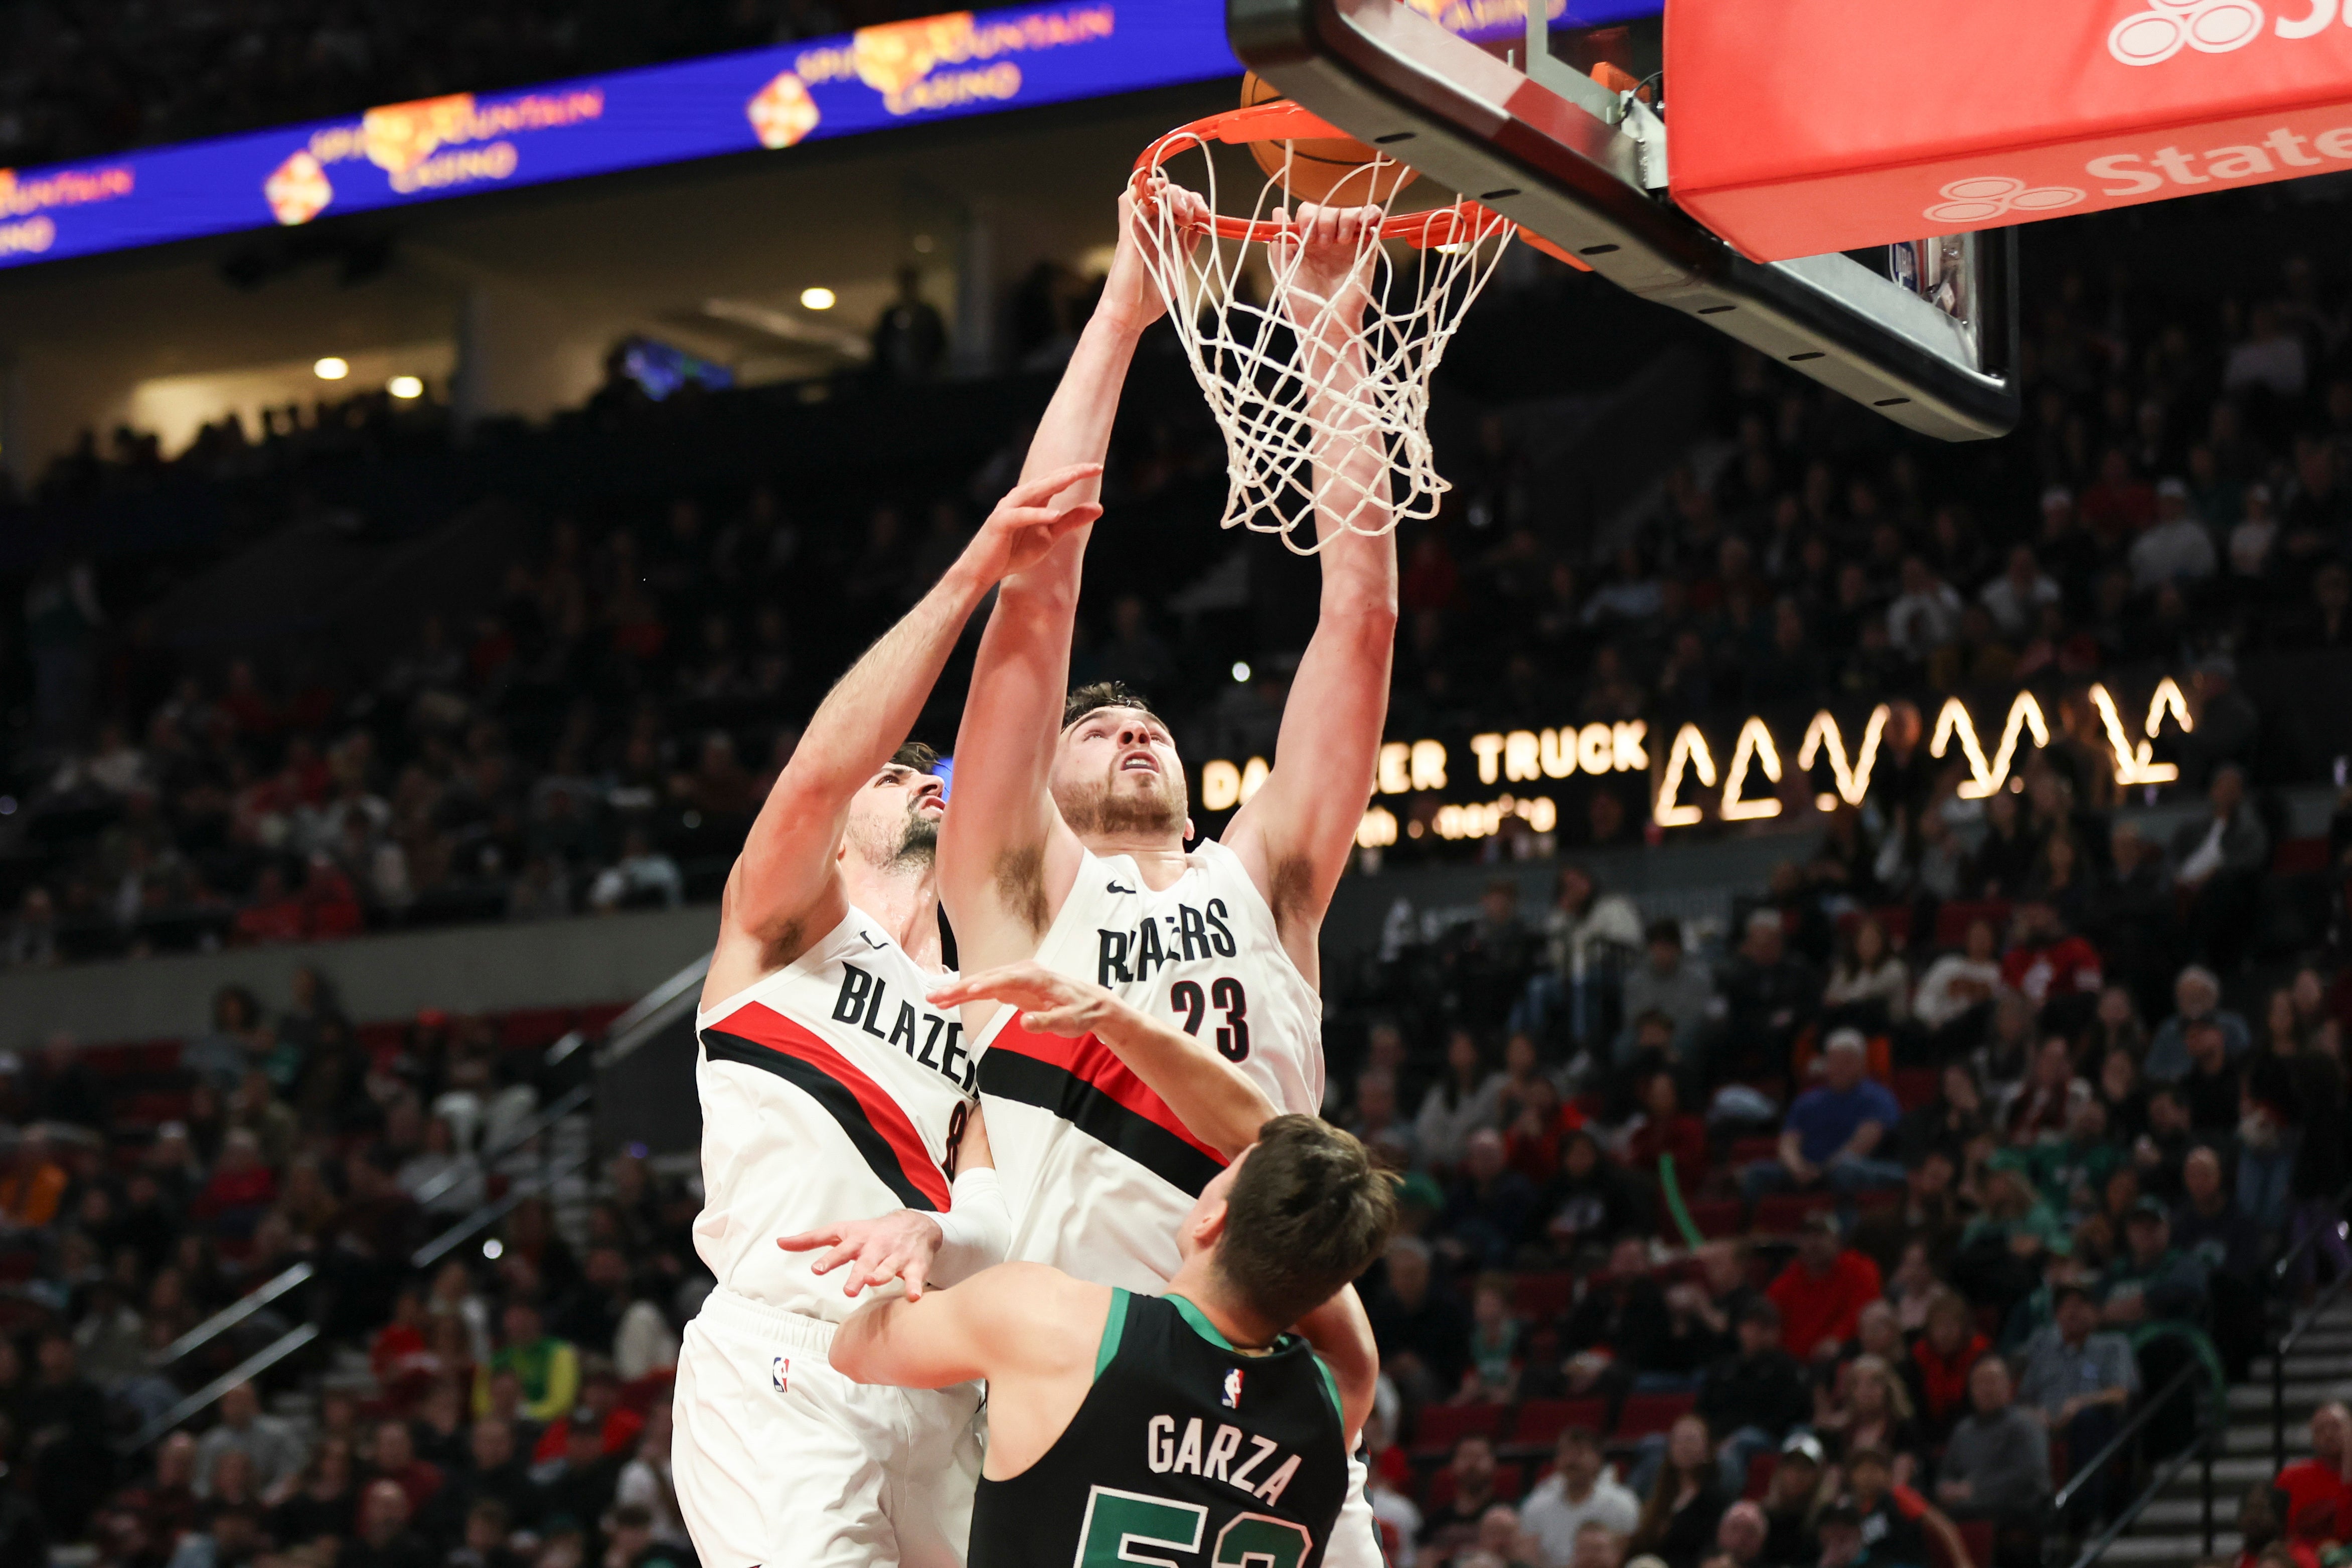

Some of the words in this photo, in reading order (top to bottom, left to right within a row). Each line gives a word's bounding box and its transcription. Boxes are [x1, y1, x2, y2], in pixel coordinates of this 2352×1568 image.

[2086, 128, 2352, 196] State
[1202, 739, 1448, 812] DAER
[1470, 719, 1649, 785] TRUCK
[1170, 977, 1249, 1063] 23
[1149, 1415, 1302, 1506] GARZA
